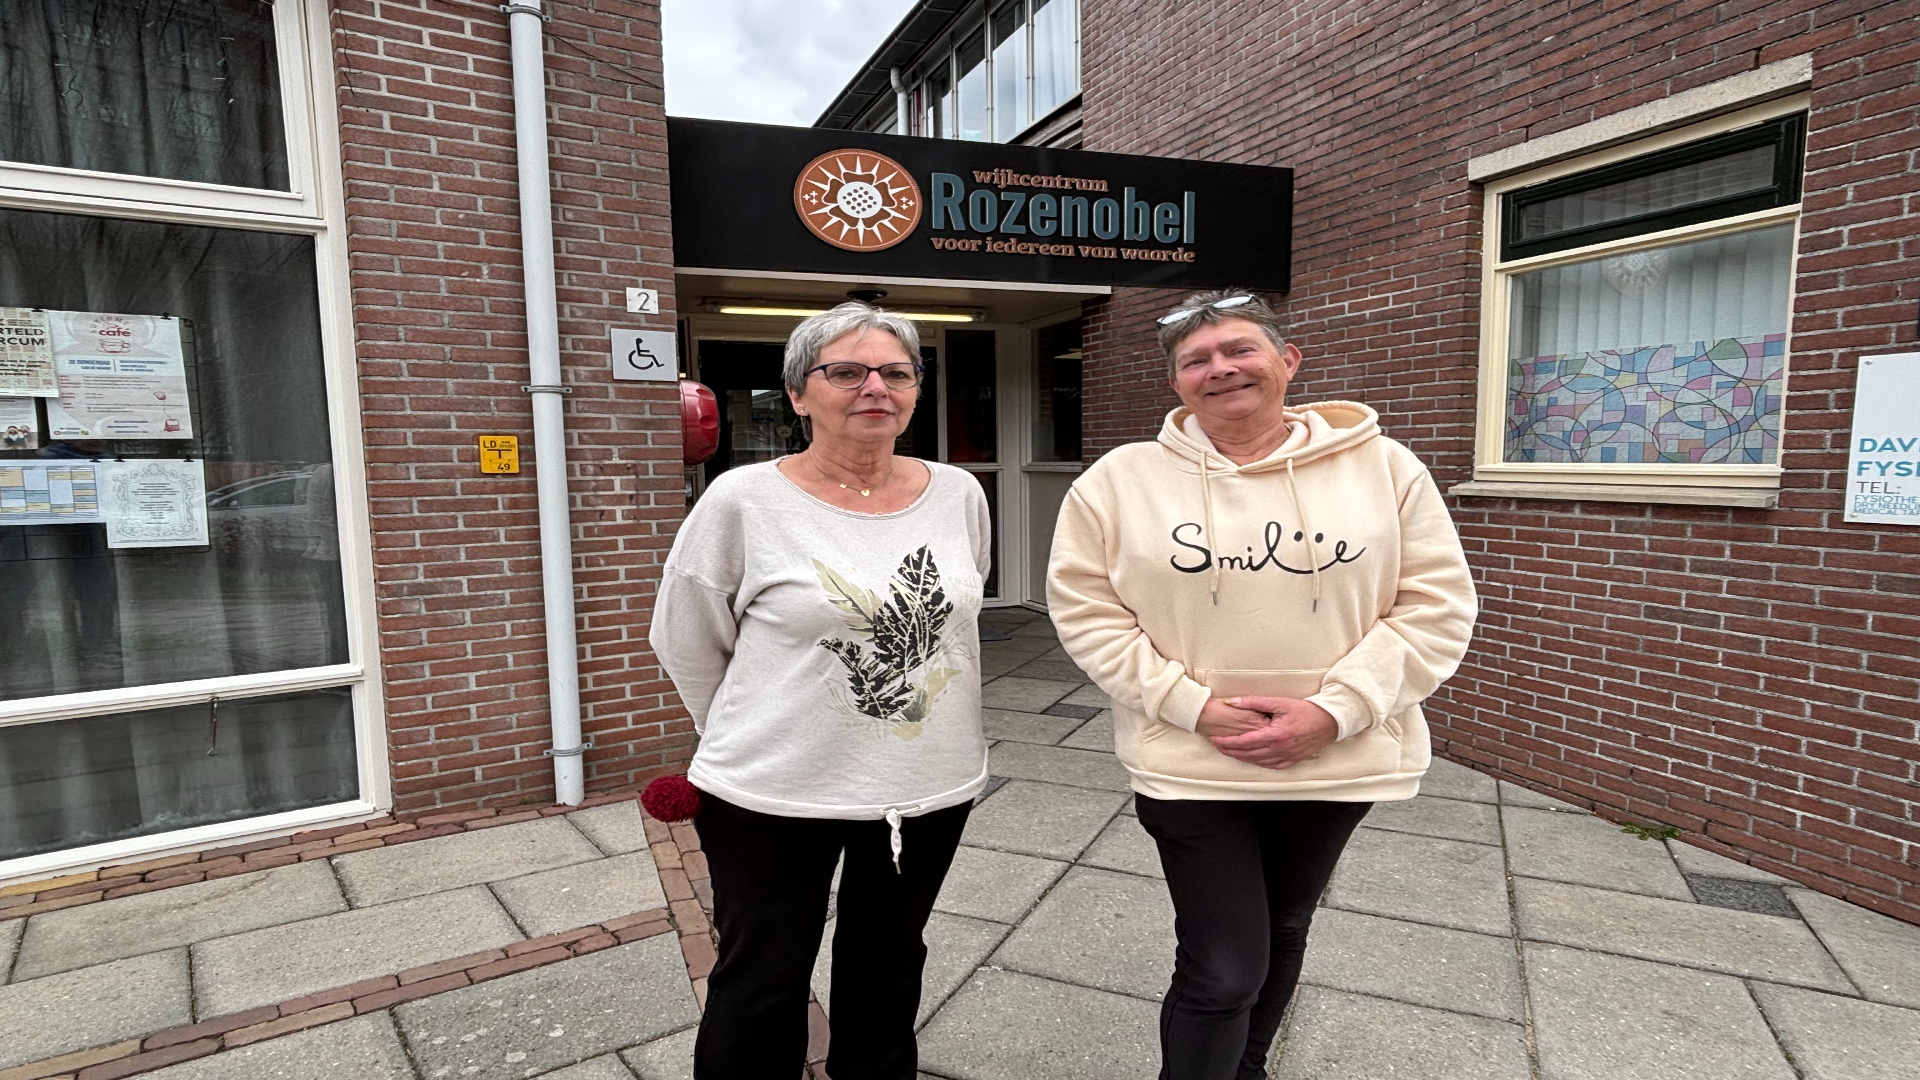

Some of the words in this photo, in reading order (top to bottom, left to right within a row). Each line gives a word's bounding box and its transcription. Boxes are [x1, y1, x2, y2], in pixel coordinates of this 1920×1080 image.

[973, 168, 1109, 192] wijkcentrum
[931, 172, 1196, 244] Rozenobel
[930, 237, 982, 252] voor
[985, 237, 1075, 257] iedereen
[1078, 245, 1118, 259] van
[1120, 247, 1196, 263] waarde
[637, 291, 651, 311] 2
[483, 440, 496, 448] LD
[1859, 437, 1920, 452] DAV
[1856, 481, 1901, 494] TEL:
[1170, 521, 1367, 575] Smile
